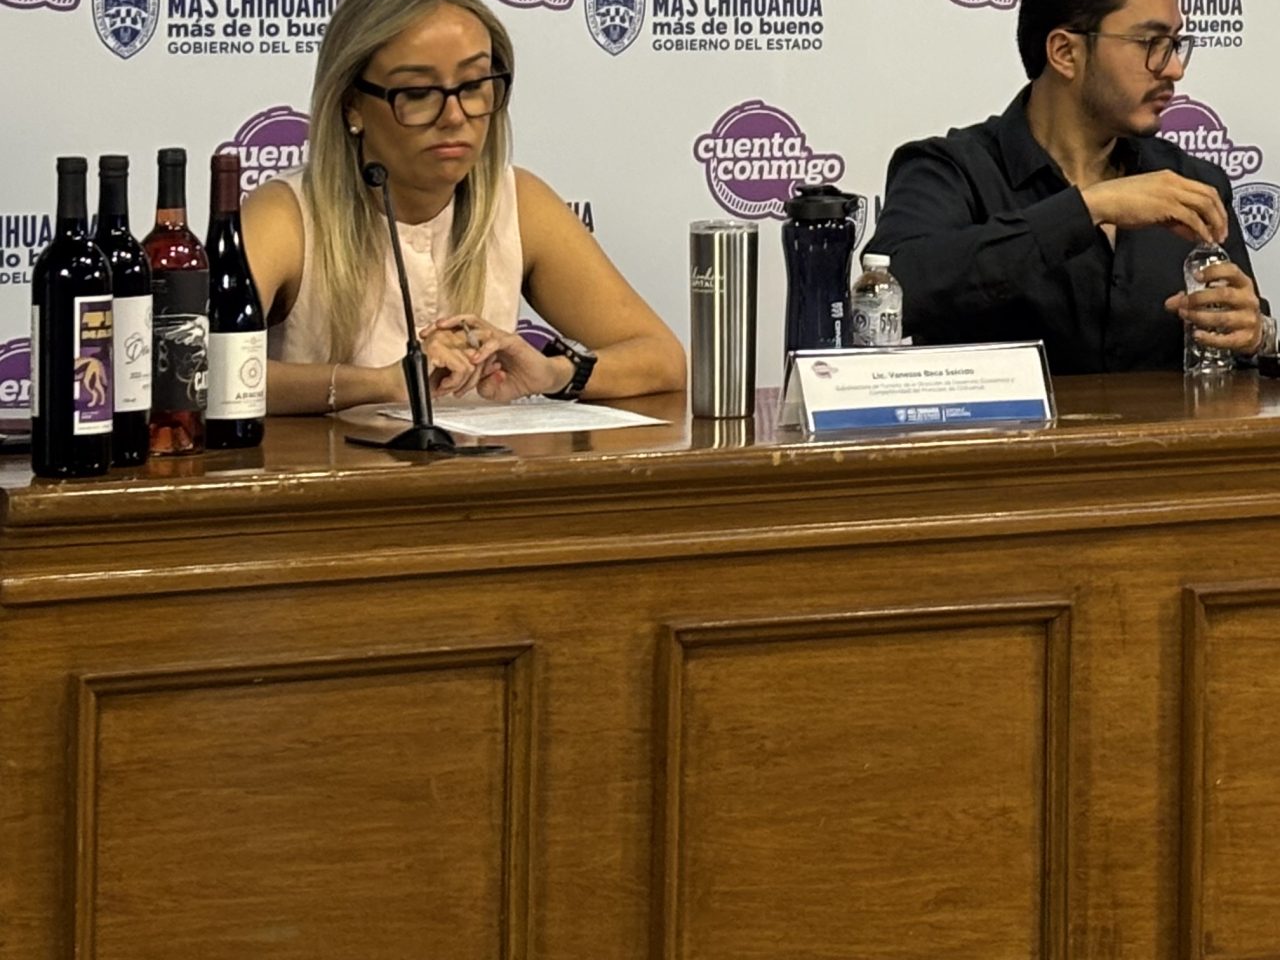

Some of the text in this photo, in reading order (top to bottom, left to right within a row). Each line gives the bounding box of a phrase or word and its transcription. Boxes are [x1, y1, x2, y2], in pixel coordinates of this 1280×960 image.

[652, 16, 824, 35] más de lo bueno
[1186, 16, 1243, 33] bueno
[652, 38, 822, 51] GOBIERNO DEL ESTADO
[698, 133, 801, 158] cuenta
[717, 159, 840, 185] conmigo
